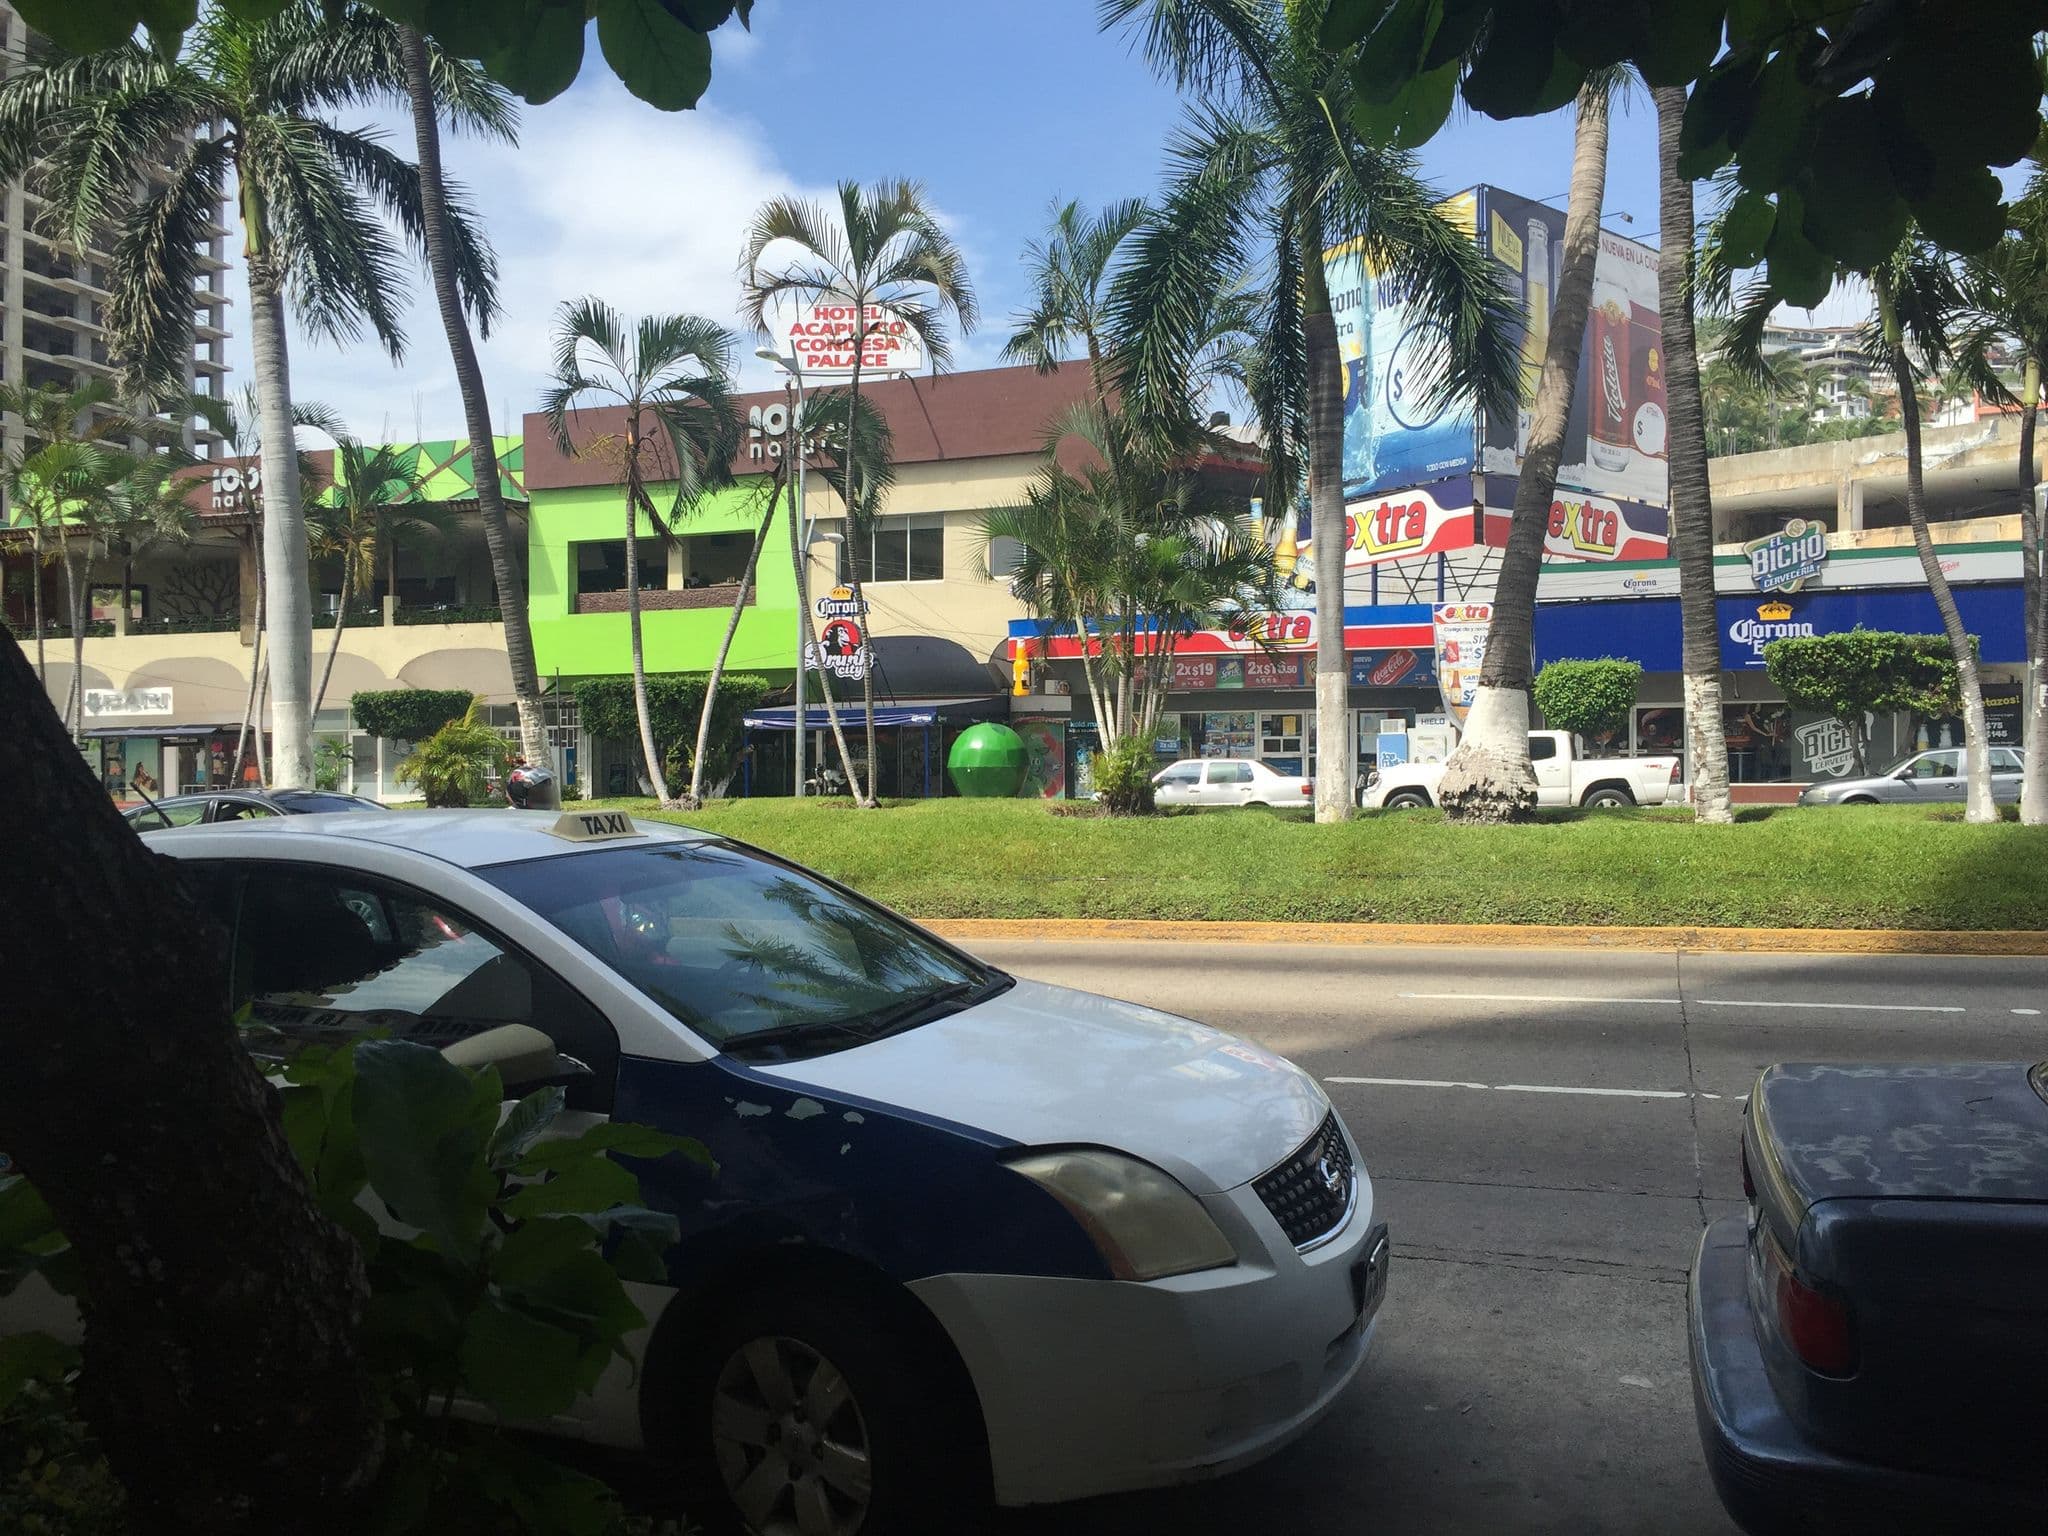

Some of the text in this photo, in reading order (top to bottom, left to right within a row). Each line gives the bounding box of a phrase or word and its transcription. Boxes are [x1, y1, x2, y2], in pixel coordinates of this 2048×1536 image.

[814, 307, 882, 320] HOTEL
[796, 338, 900, 352] CONDESA
[807, 354, 888, 368] PALACE
[1548, 500, 1618, 555] extra
[1770, 536, 1783, 548] EL
[1752, 534, 1822, 578] BICHO
[1624, 578, 1657, 589] Corona
[1445, 605, 1489, 621] extra
[1729, 619, 1814, 645] Corona
[838, 663, 863, 679] city
[1176, 662, 1214, 676] 2x$19
[1803, 728, 1852, 759] BICH
[580, 815, 626, 836] TAXI
